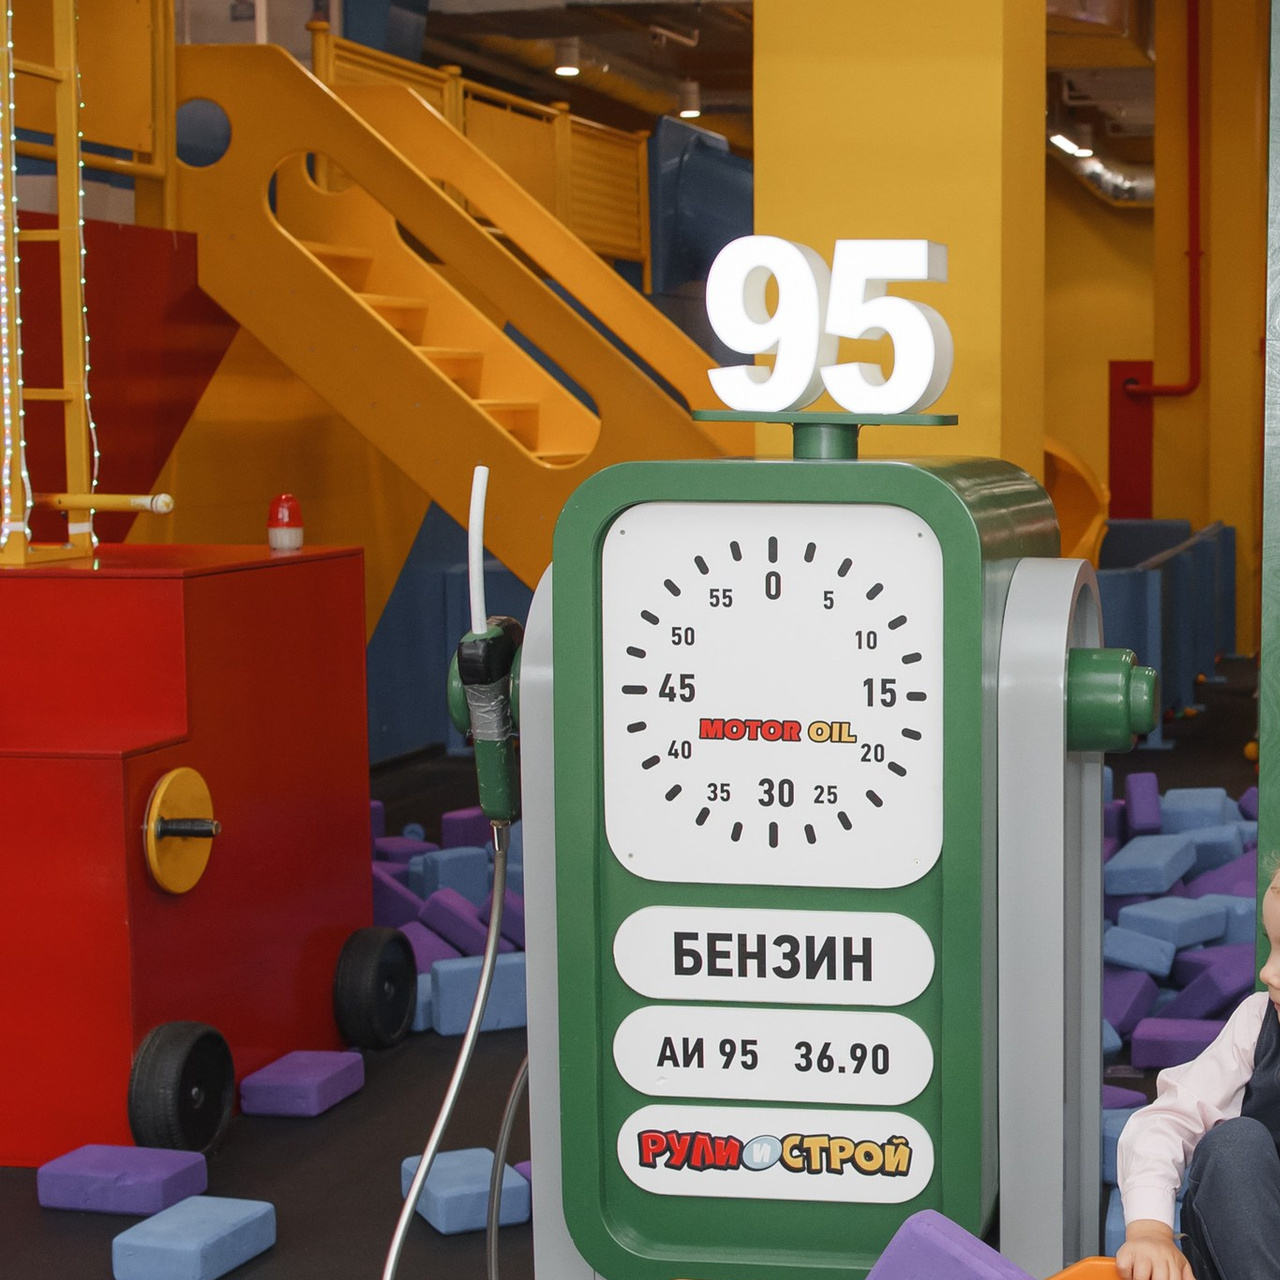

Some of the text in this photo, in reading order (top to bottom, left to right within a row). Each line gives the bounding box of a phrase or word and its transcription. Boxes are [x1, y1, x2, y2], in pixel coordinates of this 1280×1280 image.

[705, 235, 954, 414] 95
[766, 571, 781, 600] 0
[709, 588, 733, 608] 55
[823, 590, 834, 610] 5
[671, 626, 695, 646] 50
[855, 630, 878, 650] 10
[658, 673, 696, 703] 45
[863, 677, 897, 708] 15
[699, 717, 858, 744] MOTOR OIL
[667, 739, 692, 760] 40
[860, 743, 885, 763] 20
[706, 782, 731, 802] 35
[757, 777, 795, 808] 30
[813, 784, 838, 804] 25
[673, 931, 873, 982] БЕНЗИН
[656, 1036, 890, 1075] АИ 95 36.90
